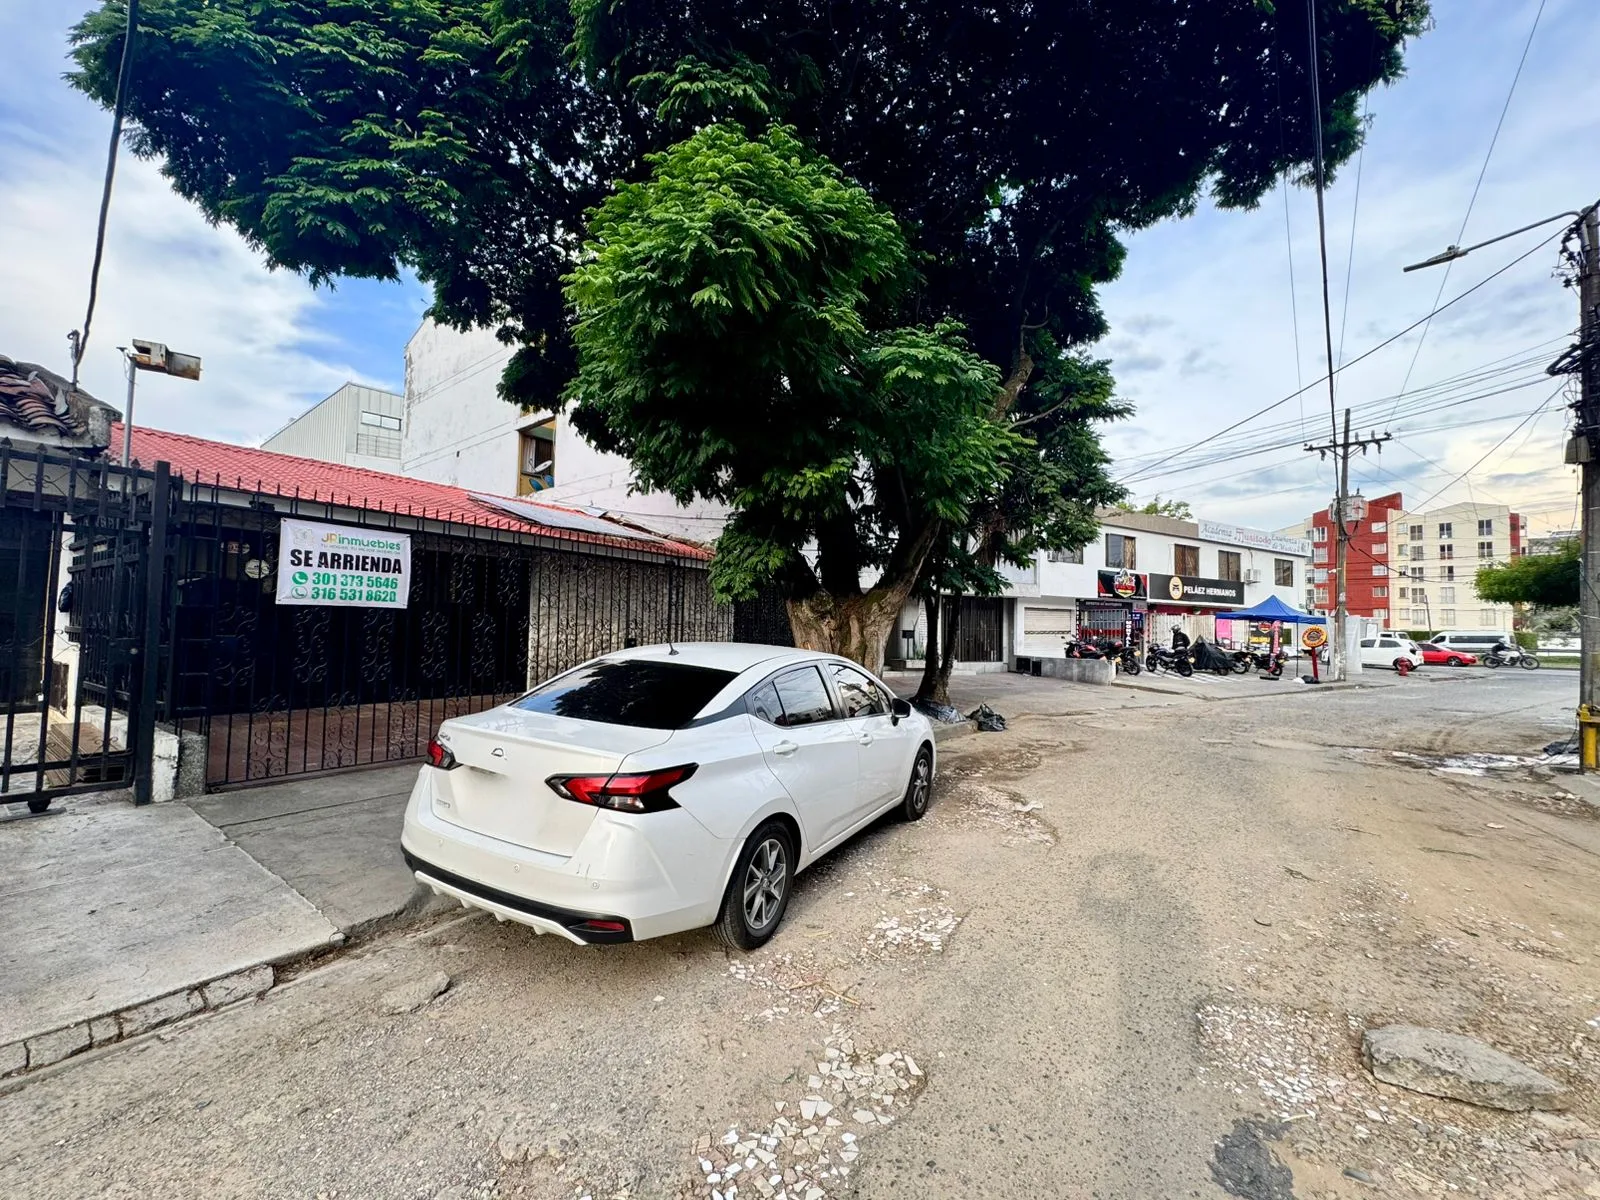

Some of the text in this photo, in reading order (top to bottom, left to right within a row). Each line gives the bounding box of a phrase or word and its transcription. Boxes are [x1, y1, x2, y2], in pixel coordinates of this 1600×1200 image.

[290, 549, 402, 574] SE ARRIENDA
[312, 572, 398, 589] 301 373 5646
[311, 586, 396, 603] 316 531 8620
[1183, 585, 1236, 597] PELÁEZ HERMANOS
